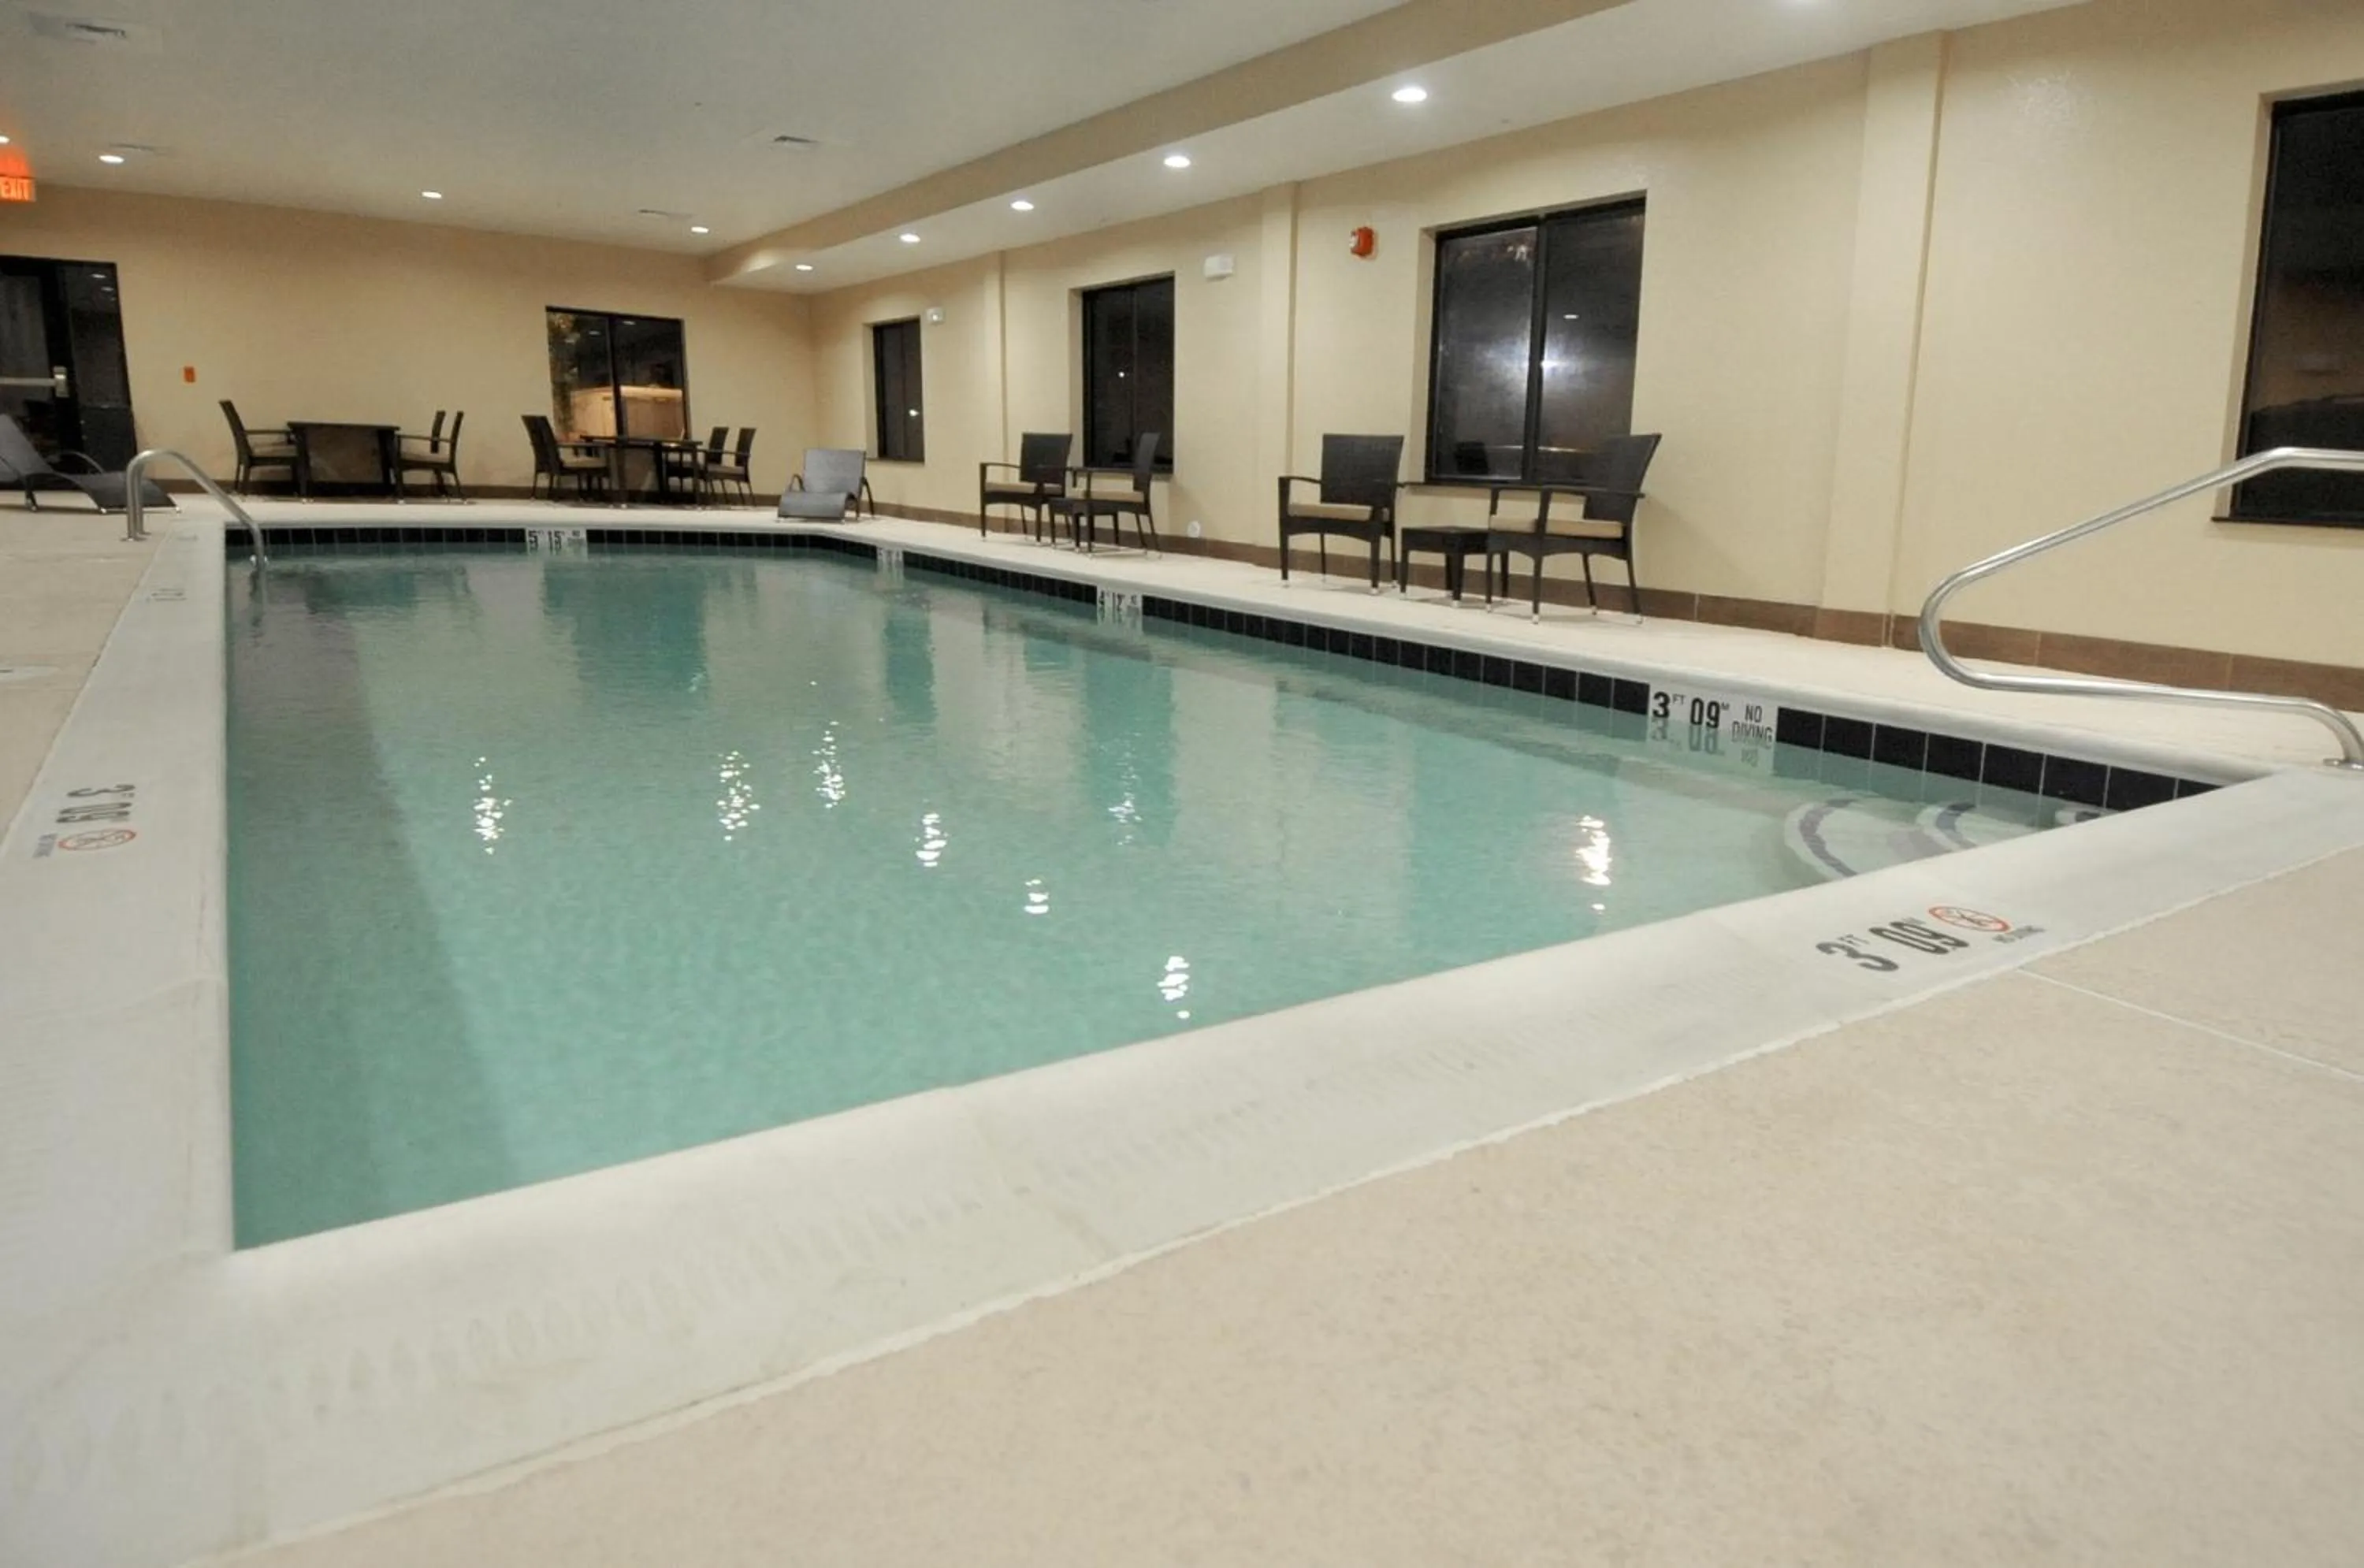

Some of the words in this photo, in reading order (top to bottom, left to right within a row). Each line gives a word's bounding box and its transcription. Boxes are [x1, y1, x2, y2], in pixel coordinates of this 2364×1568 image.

[1653, 691, 1671, 719] 3
[1672, 693, 1686, 705] FT
[1689, 697, 1720, 728] 09
[1745, 704, 1763, 723] NO
[1731, 720, 1773, 743] DIVING
[1815, 942, 1900, 972] 3
